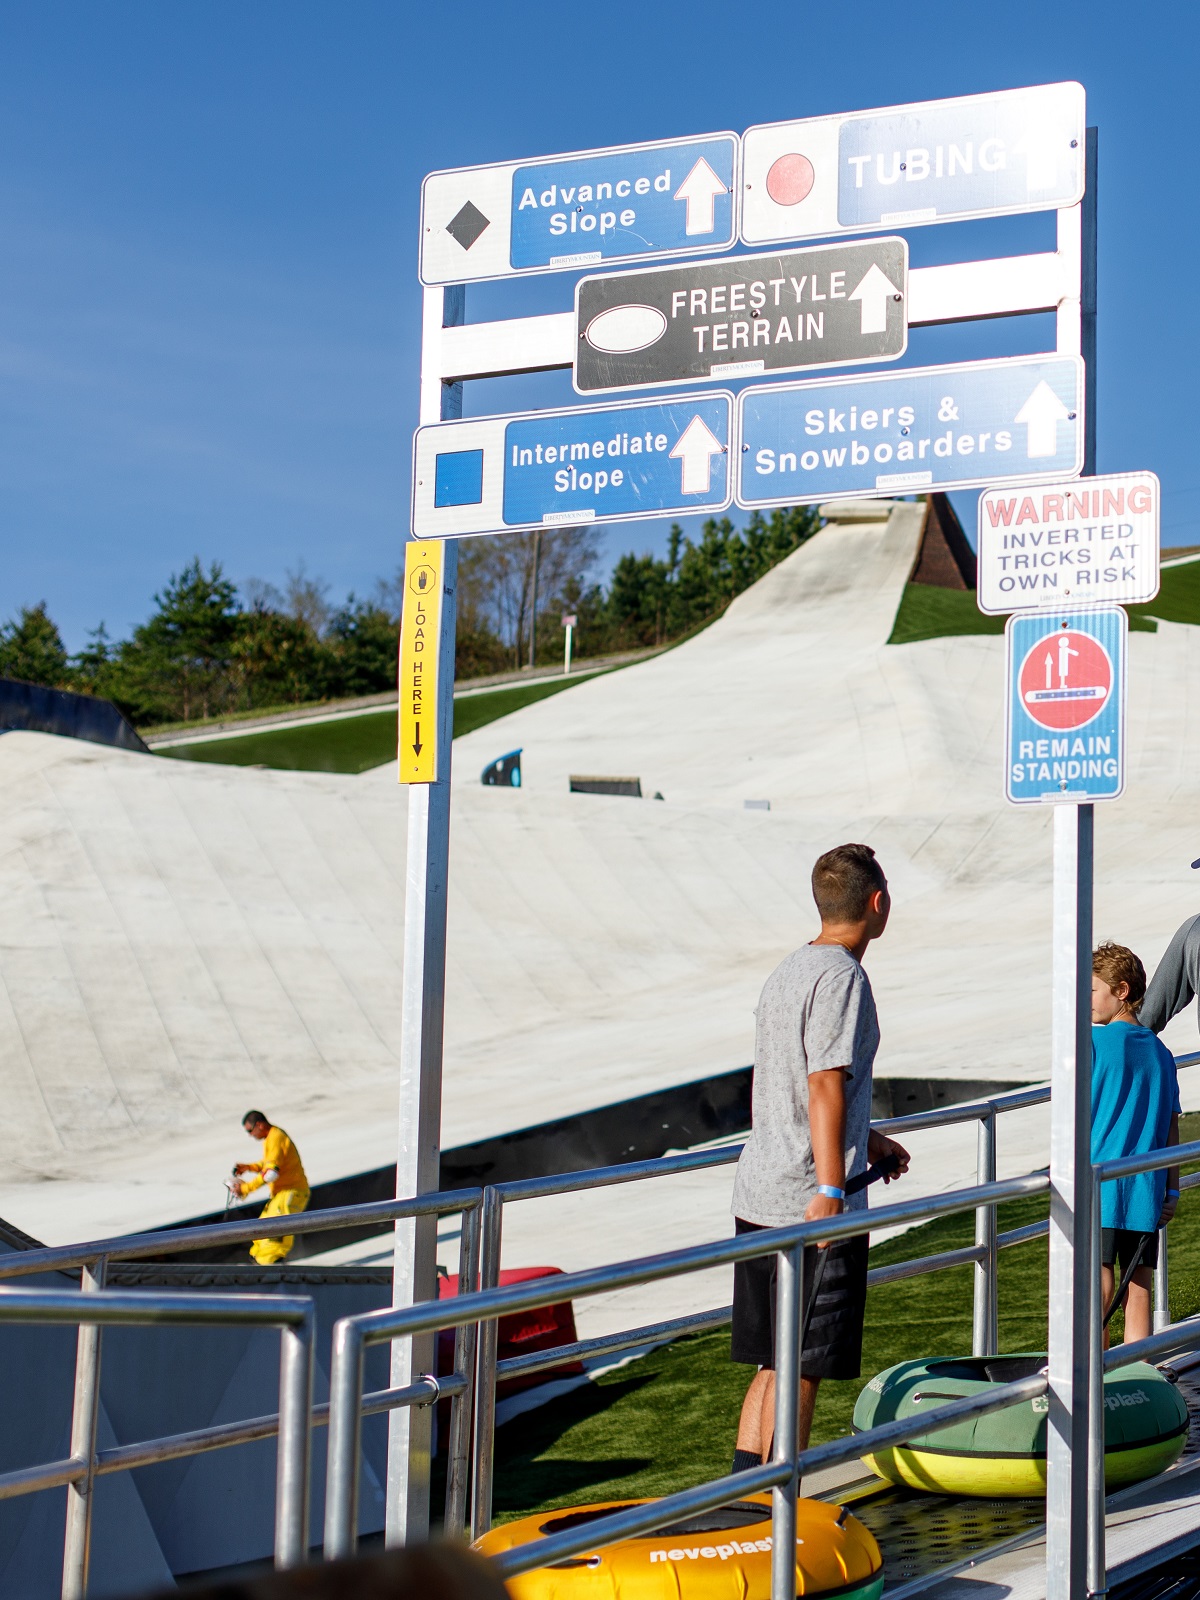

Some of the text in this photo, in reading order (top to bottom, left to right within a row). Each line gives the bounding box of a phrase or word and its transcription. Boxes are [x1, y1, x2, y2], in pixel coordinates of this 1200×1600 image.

[848, 138, 1007, 188] TUBING
[518, 169, 671, 210] Advanced
[549, 209, 636, 235] Slope
[671, 270, 846, 318] FREESTYLE
[693, 312, 824, 353] TERRAIN
[804, 396, 960, 436] Skiers &
[512, 431, 668, 467] Intermediate
[755, 430, 1012, 475] Snowboarders
[554, 468, 624, 494] Slope
[985, 485, 1152, 528] WARNING
[1003, 523, 1134, 550] INVERTED
[997, 544, 1140, 571] TRICKS AT
[999, 565, 1137, 592] OWN RISK
[412, 601, 426, 715] LOAD HERE
[1019, 736, 1111, 760] REMAIN
[1012, 758, 1117, 783] STANDING
